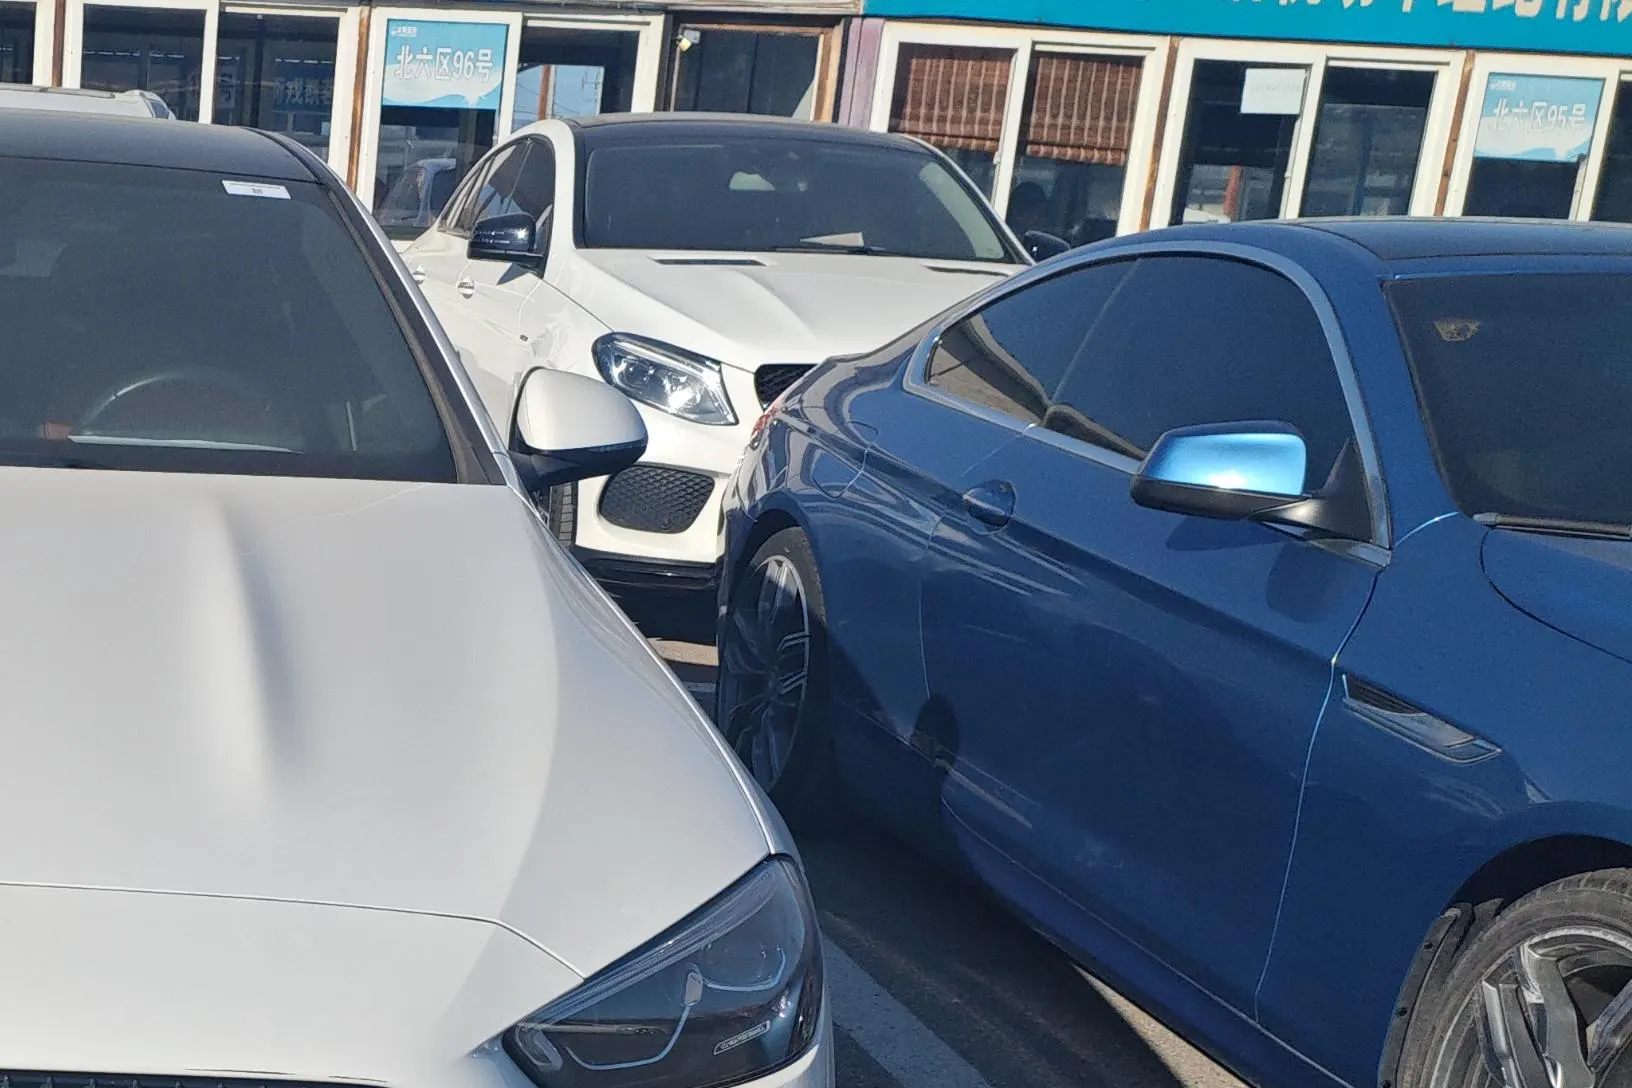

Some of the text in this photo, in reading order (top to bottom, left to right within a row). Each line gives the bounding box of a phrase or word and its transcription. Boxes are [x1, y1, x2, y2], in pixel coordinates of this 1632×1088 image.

[395, 44, 493, 82] 北六区96号
[1491, 98, 1586, 134] 北六区95号
